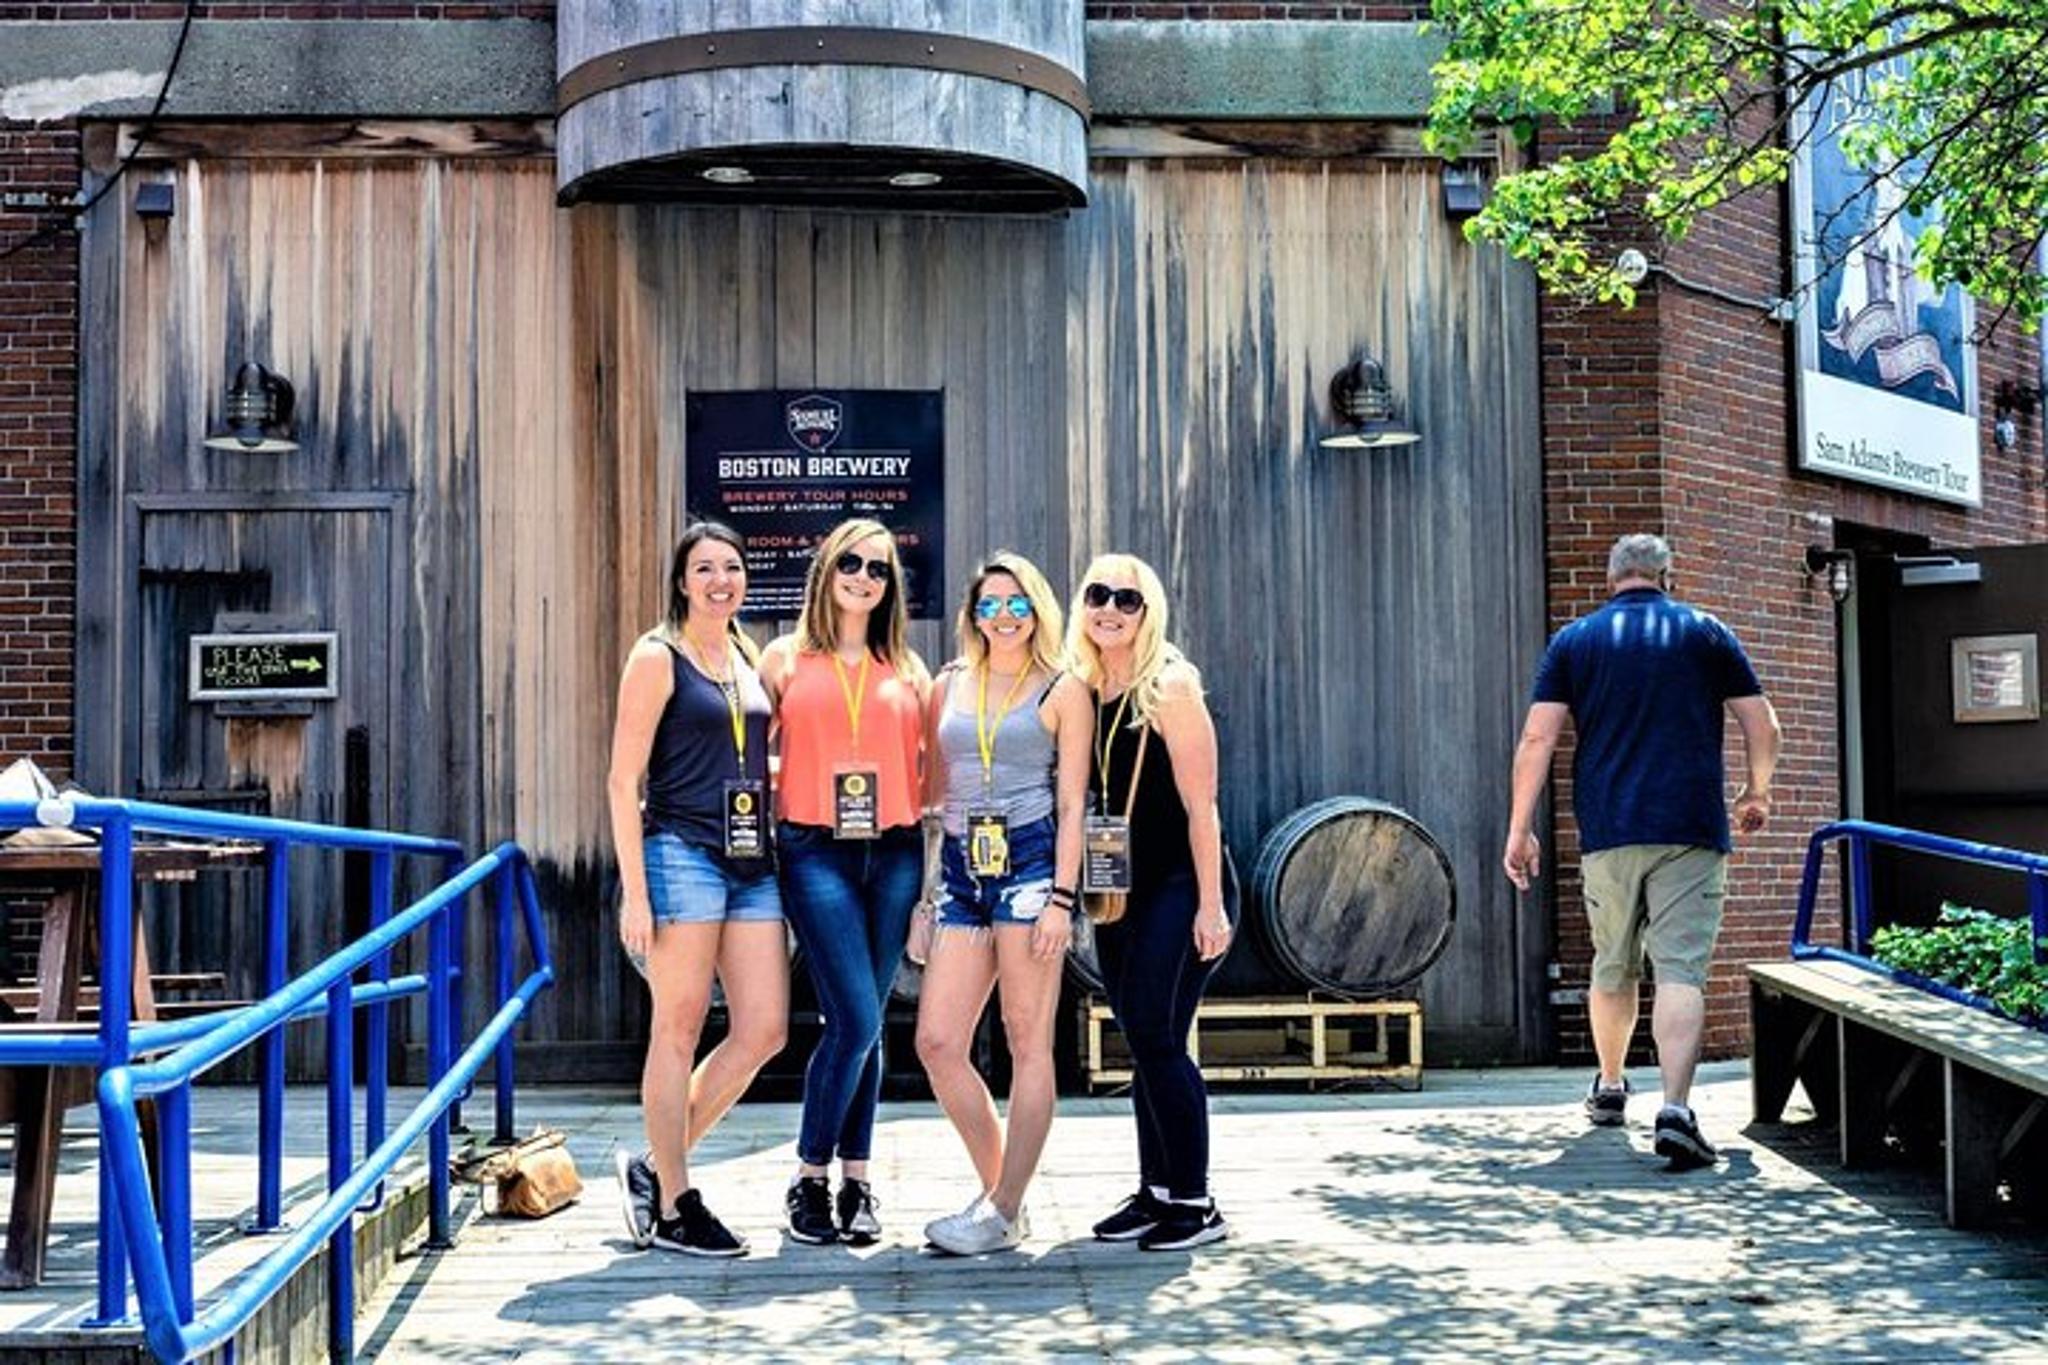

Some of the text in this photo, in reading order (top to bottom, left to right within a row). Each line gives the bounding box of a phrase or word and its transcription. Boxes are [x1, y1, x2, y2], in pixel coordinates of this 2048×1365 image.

[718, 457, 911, 479] BOSTON BREWERY
[1816, 431, 1968, 492] Sam Adams Brewery Tour
[722, 489, 908, 503] BREWERY TOUR HOURS
[747, 536, 791, 547] ROOM
[212, 644, 286, 665] PLEASE
